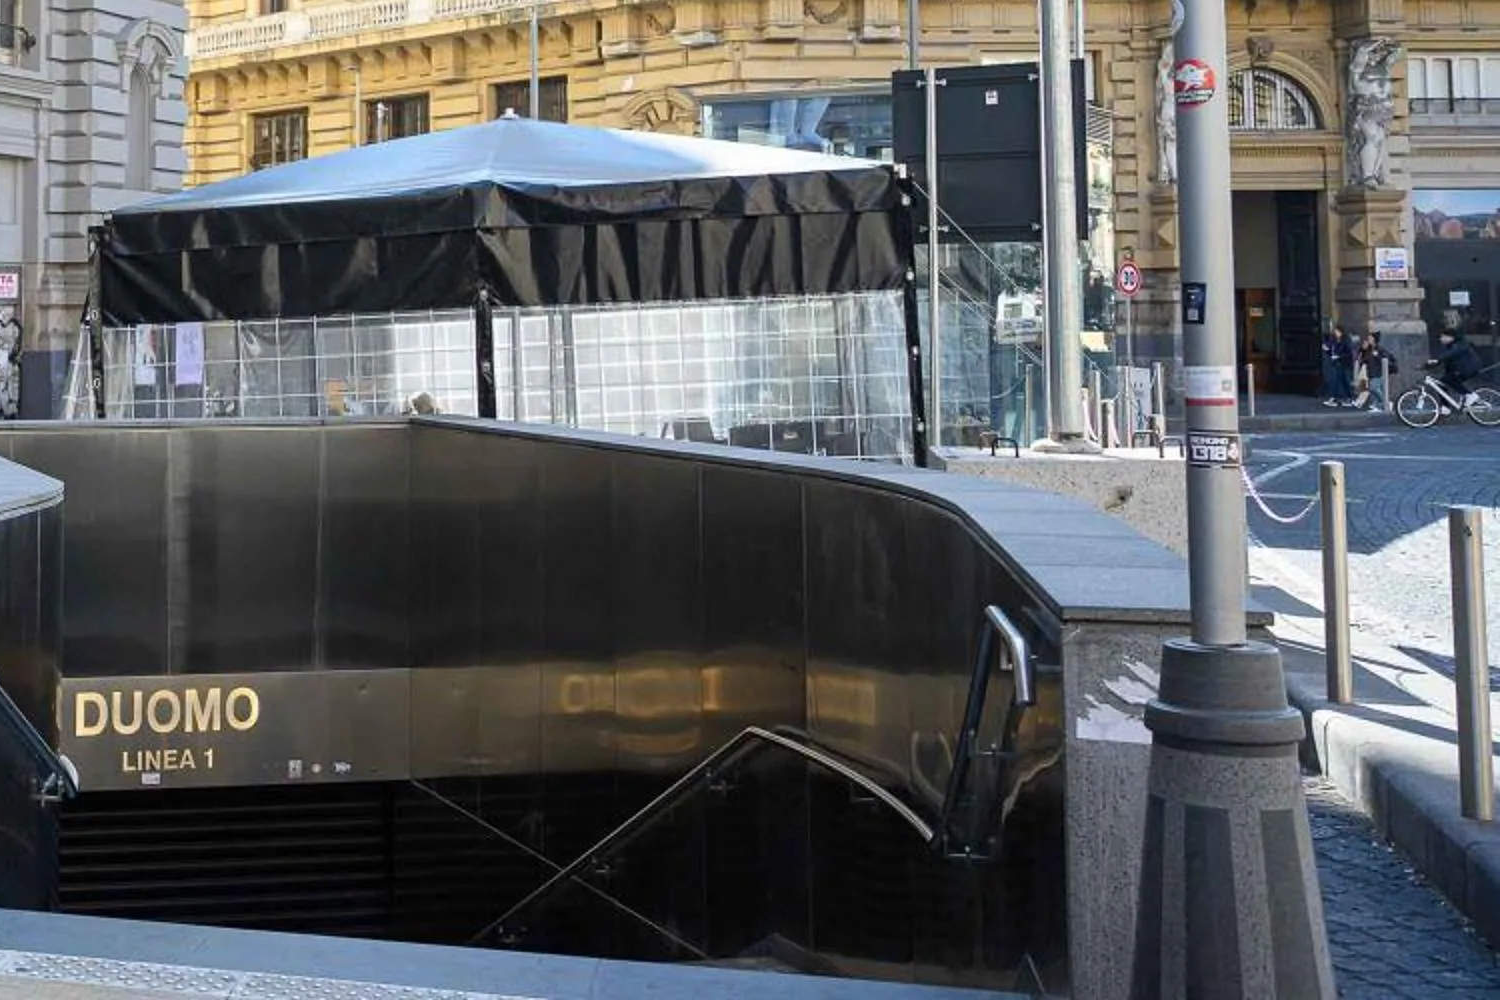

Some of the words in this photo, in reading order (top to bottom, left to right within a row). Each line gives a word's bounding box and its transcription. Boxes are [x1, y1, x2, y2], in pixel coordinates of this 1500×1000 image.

[75, 687, 260, 737] DUOMO
[122, 750, 196, 772] LINEA
[203, 748, 214, 769] 1
